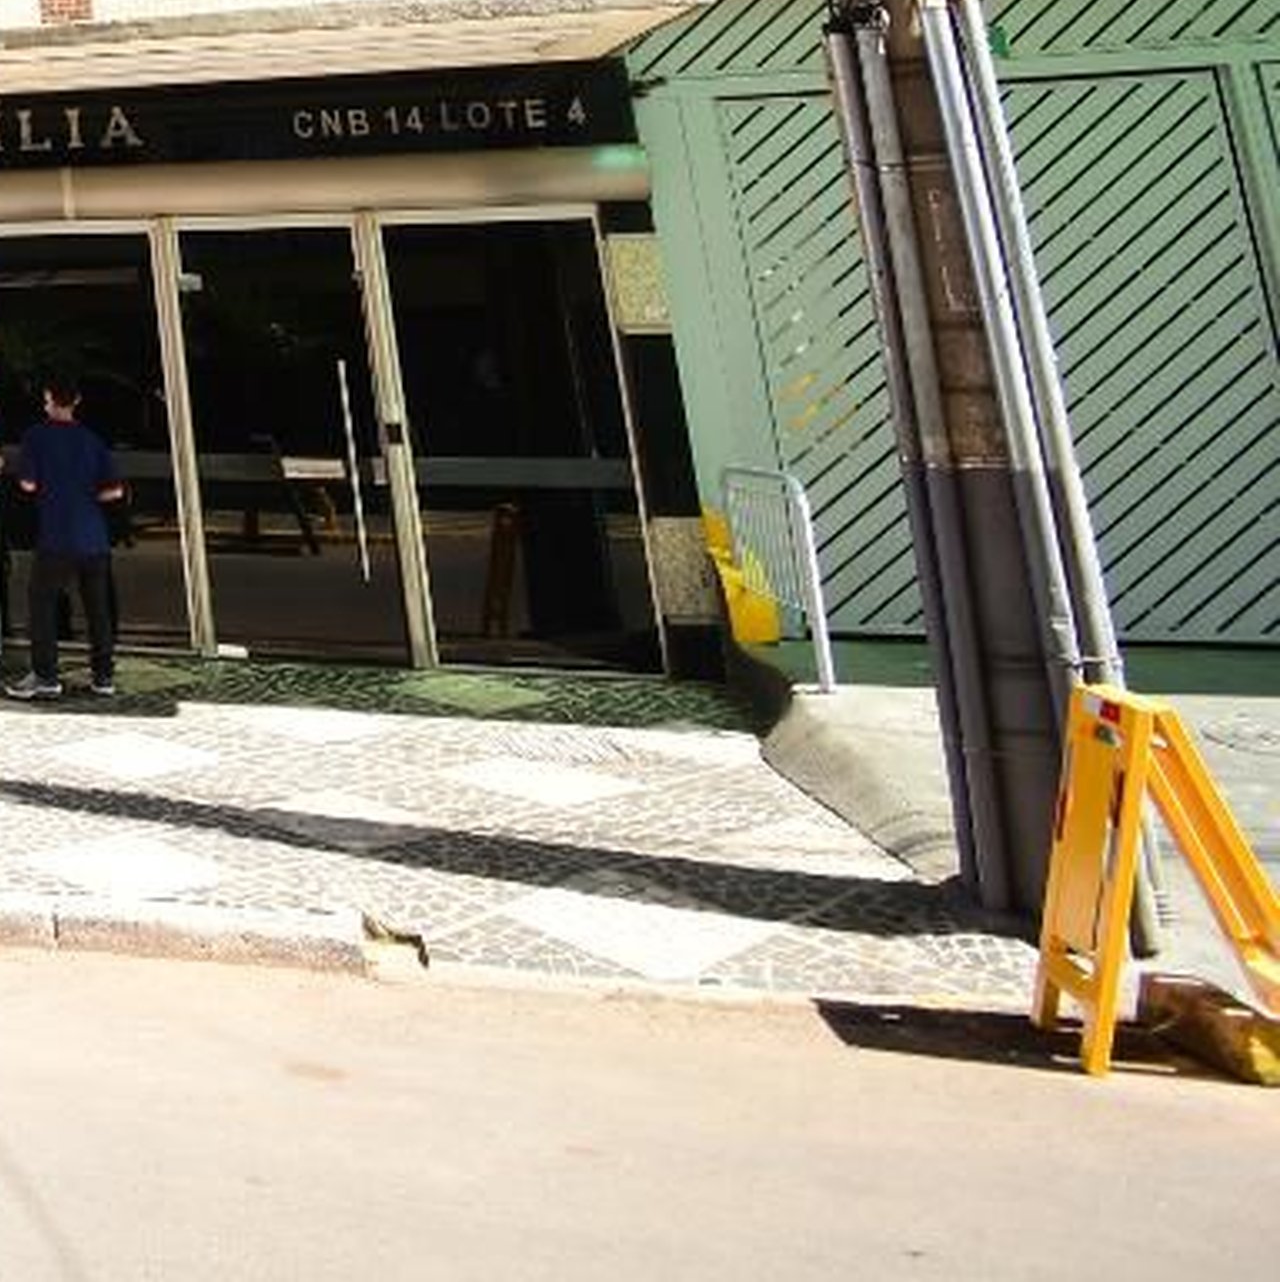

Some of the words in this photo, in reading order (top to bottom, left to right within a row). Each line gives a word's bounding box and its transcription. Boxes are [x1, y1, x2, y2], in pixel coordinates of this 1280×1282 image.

[292, 109, 370, 138] CNB
[384, 106, 425, 135] 14
[440, 99, 547, 132] LOTE
[566, 97, 587, 126] 4
